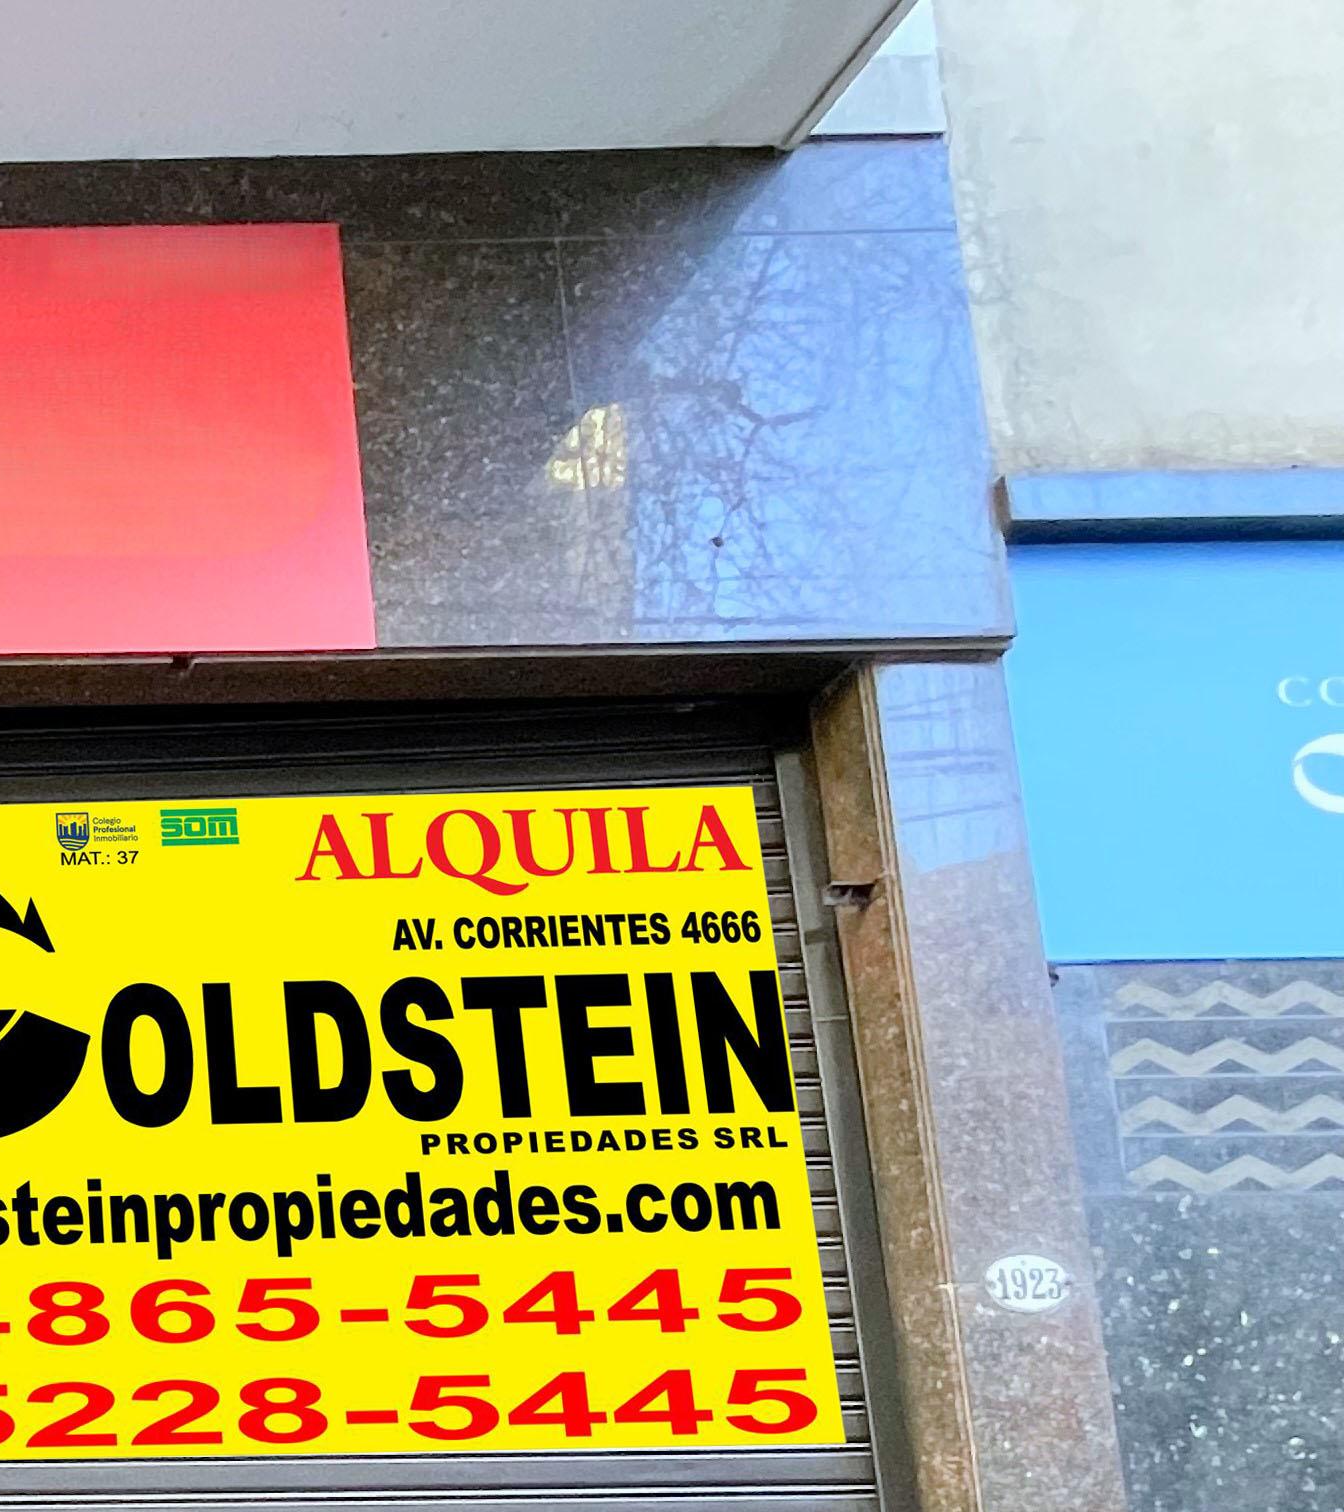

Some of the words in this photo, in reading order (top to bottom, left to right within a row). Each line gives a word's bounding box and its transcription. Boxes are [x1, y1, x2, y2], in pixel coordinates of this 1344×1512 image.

[92, 817, 121, 826] Colegio
[93, 825, 136, 834] Profesional
[93, 834, 139, 842] Inmobiliario
[61, 851, 110, 866] MAT.:
[117, 850, 139, 865] 37
[295, 805, 752, 896] ALQUILA
[393, 918, 443, 951] AV.
[453, 912, 671, 950] CORRIENTES
[681, 910, 761, 944] 4666
[420, 1128, 699, 1155] PROPIEDADES
[714, 1126, 788, 1149] SRL
[997, 1268, 1062, 1300] 1923
